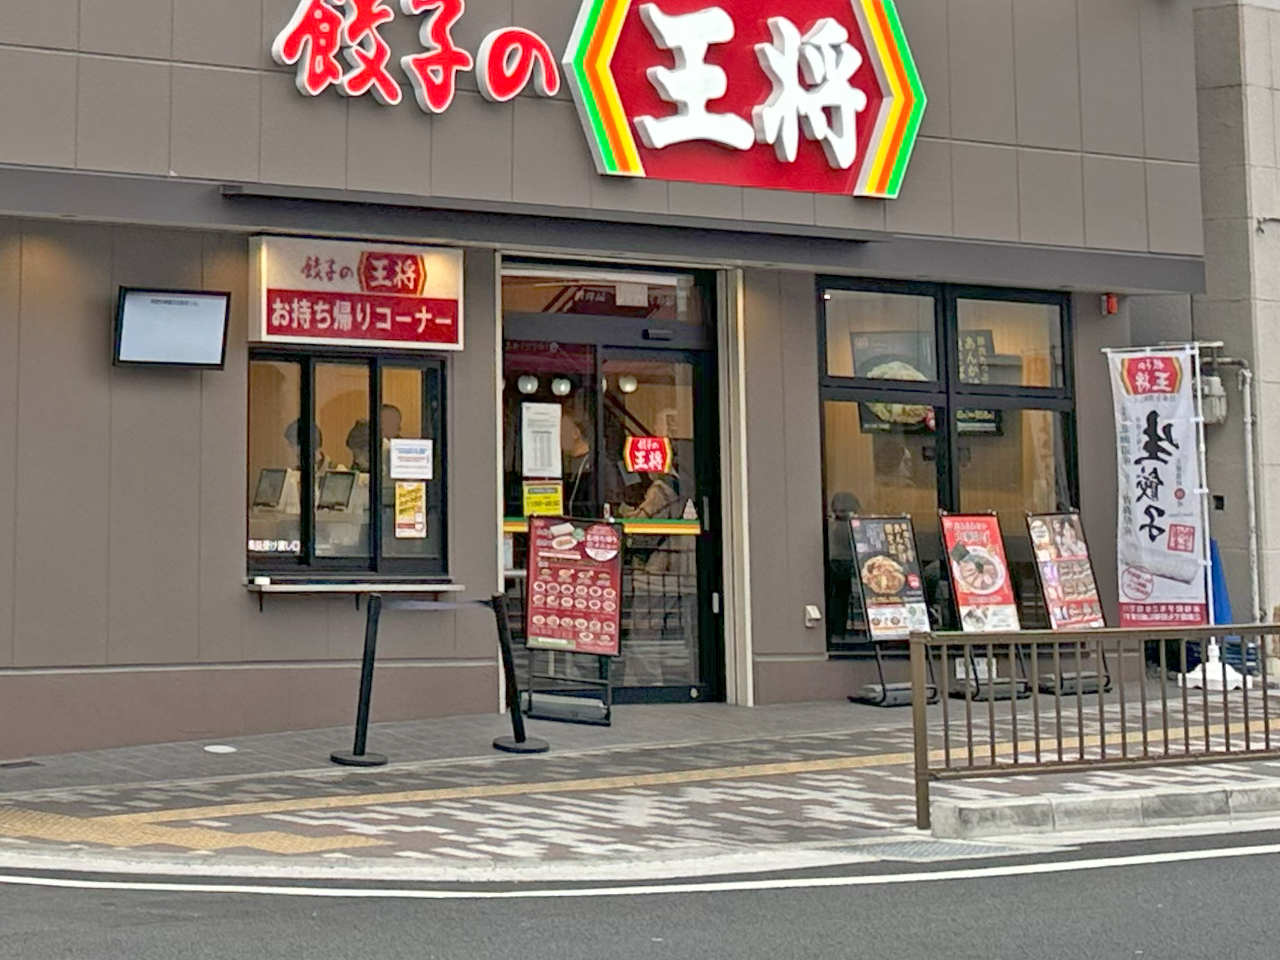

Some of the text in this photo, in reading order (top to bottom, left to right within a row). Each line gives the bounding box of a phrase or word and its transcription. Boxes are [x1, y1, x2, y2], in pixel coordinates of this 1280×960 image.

[633, 2, 867, 170] 王将
[300, 254, 416, 290] 餃子の 王将
[271, 297, 452, 333] お持ち帰りコーナー
[634, 451, 664, 471] 王将
